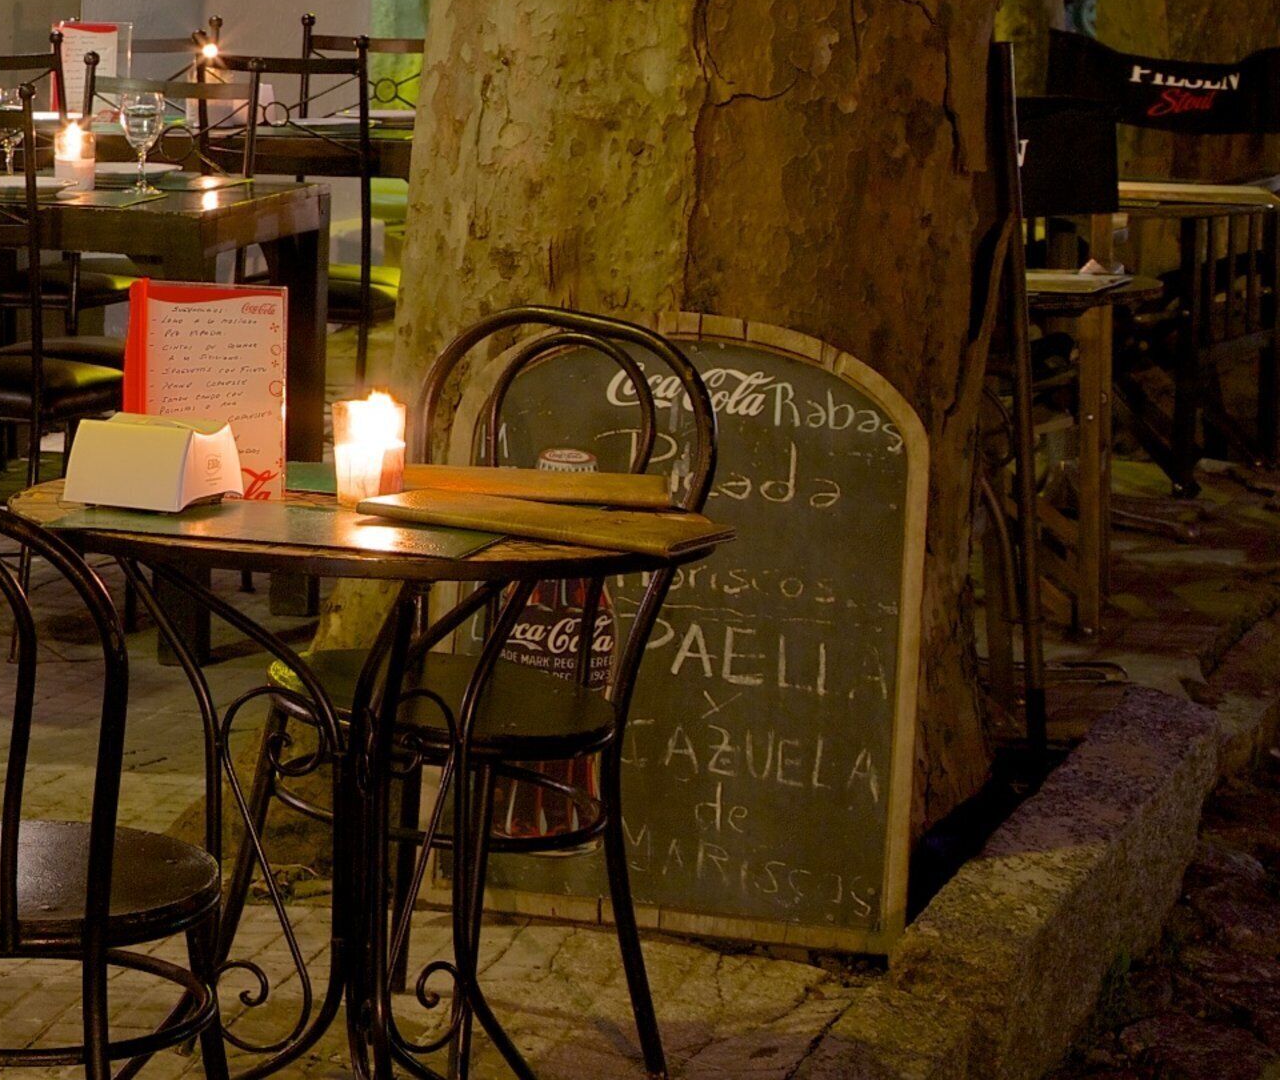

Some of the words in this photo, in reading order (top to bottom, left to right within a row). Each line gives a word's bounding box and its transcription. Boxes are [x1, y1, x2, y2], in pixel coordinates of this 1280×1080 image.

[240, 302, 277, 316] Coca-Cola
[765, 383, 904, 452] Rabas
[520, 653, 550, 668] MARK
[553, 655, 615, 669] REGERED
[695, 782, 749, 833] de
